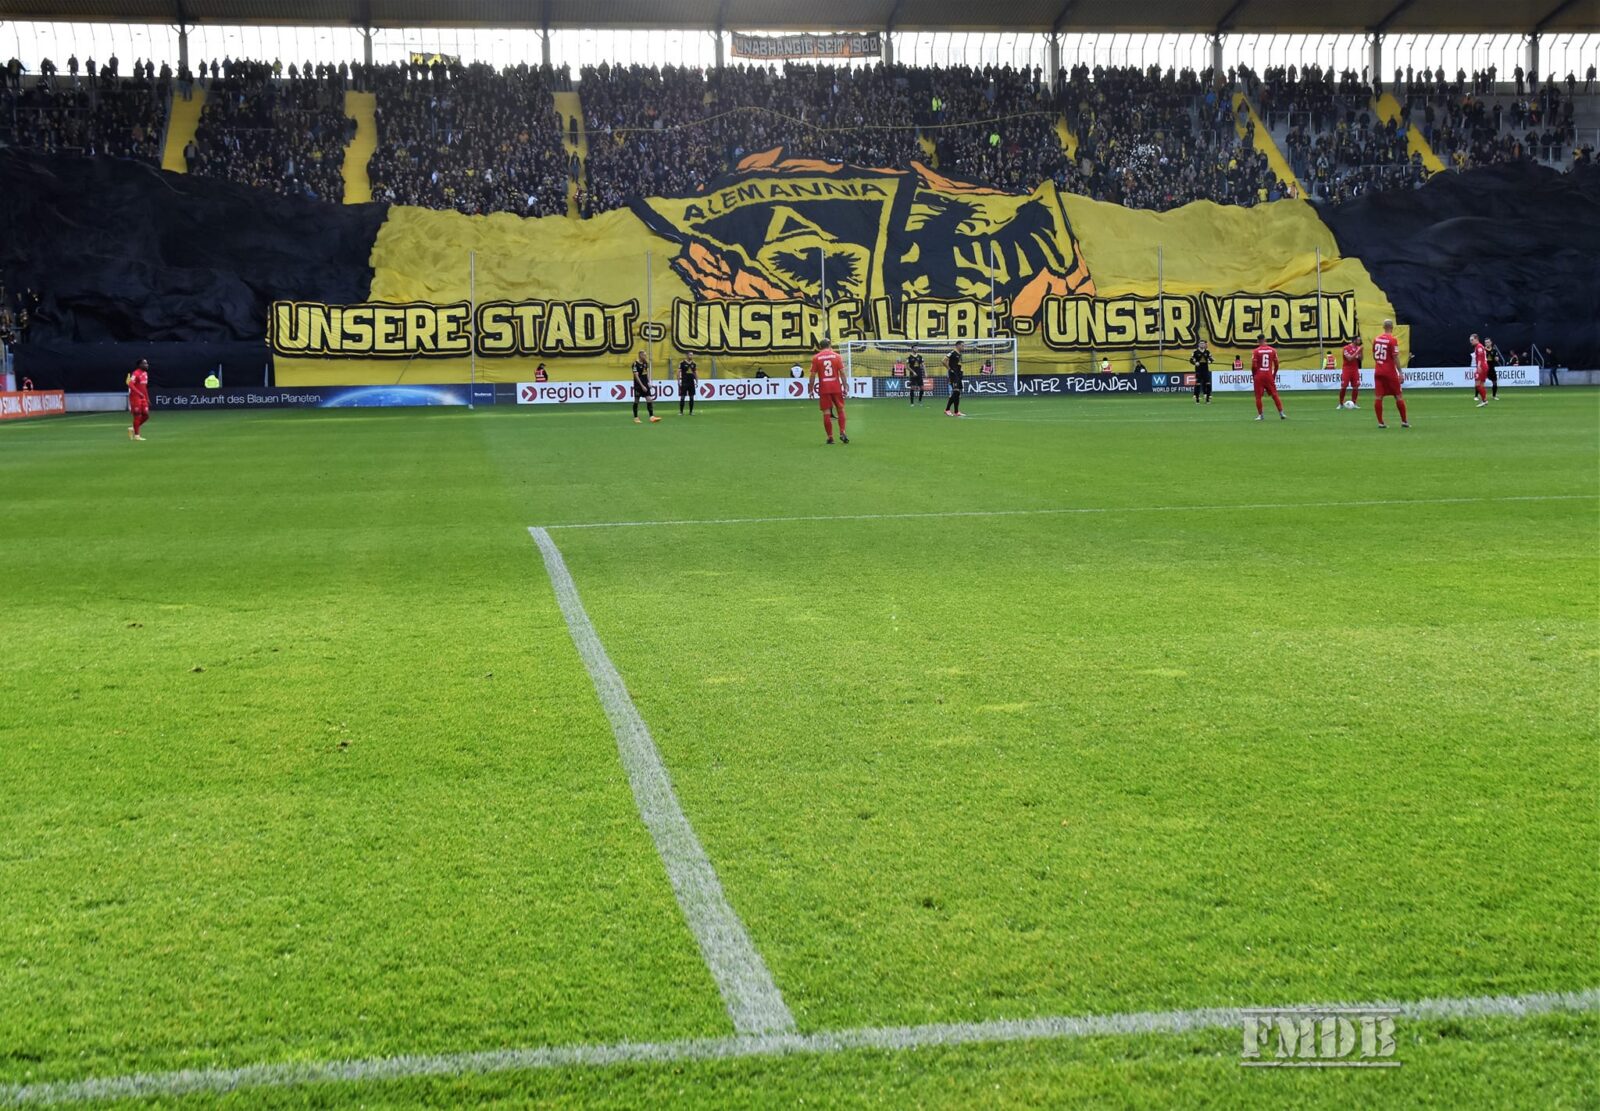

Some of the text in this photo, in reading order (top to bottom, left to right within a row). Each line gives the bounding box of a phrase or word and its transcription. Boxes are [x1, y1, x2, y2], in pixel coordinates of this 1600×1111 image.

[817, 38, 845, 54] SEIT
[850, 37, 878, 53] 1900
[683, 180, 888, 222] ALEMANNIA
[274, 302, 473, 353] UNSERE
[480, 301, 639, 352] STADT
[676, 299, 862, 351] UNSERE
[875, 298, 1010, 344] LIEBE
[1046, 297, 1195, 344] UNSER
[1206, 295, 1355, 342] VEREIN
[1374, 343, 1388, 360] 25
[823, 360, 833, 376] 3
[1262, 354, 1269, 368] 6
[961, 376, 1138, 393] TNESS UNTER FREUNDEN
[1402, 371, 1444, 381] NVERGLEICH
[540, 382, 584, 402] regio
[630, 381, 674, 400] rgio
[719, 379, 762, 399] regio
[155, 393, 323, 405] Für die Zukunft des Blauen Planeten.
